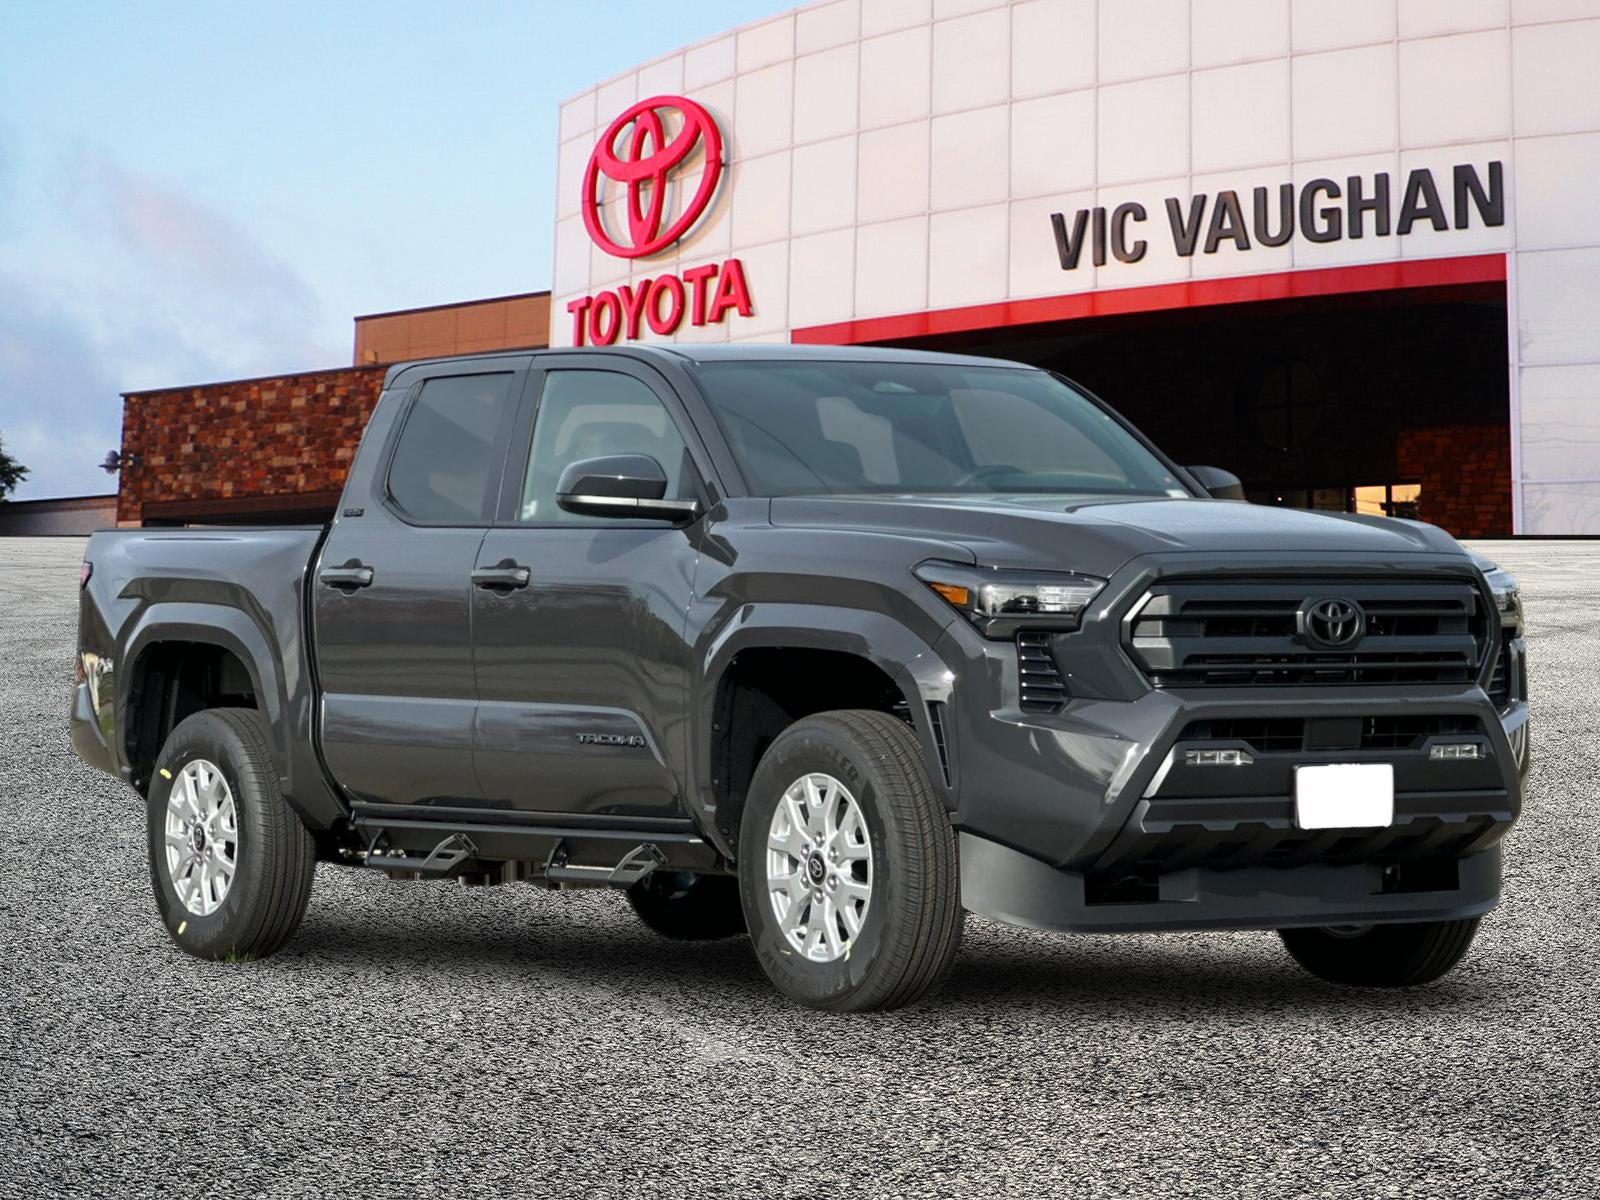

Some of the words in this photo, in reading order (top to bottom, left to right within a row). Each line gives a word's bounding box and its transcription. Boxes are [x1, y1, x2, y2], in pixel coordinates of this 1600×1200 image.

[1050, 202, 1147, 270] VIC
[1165, 160, 1504, 257] VAUGHAN
[567, 259, 753, 347] TOYOTA
[576, 733, 645, 747] TACOMA
